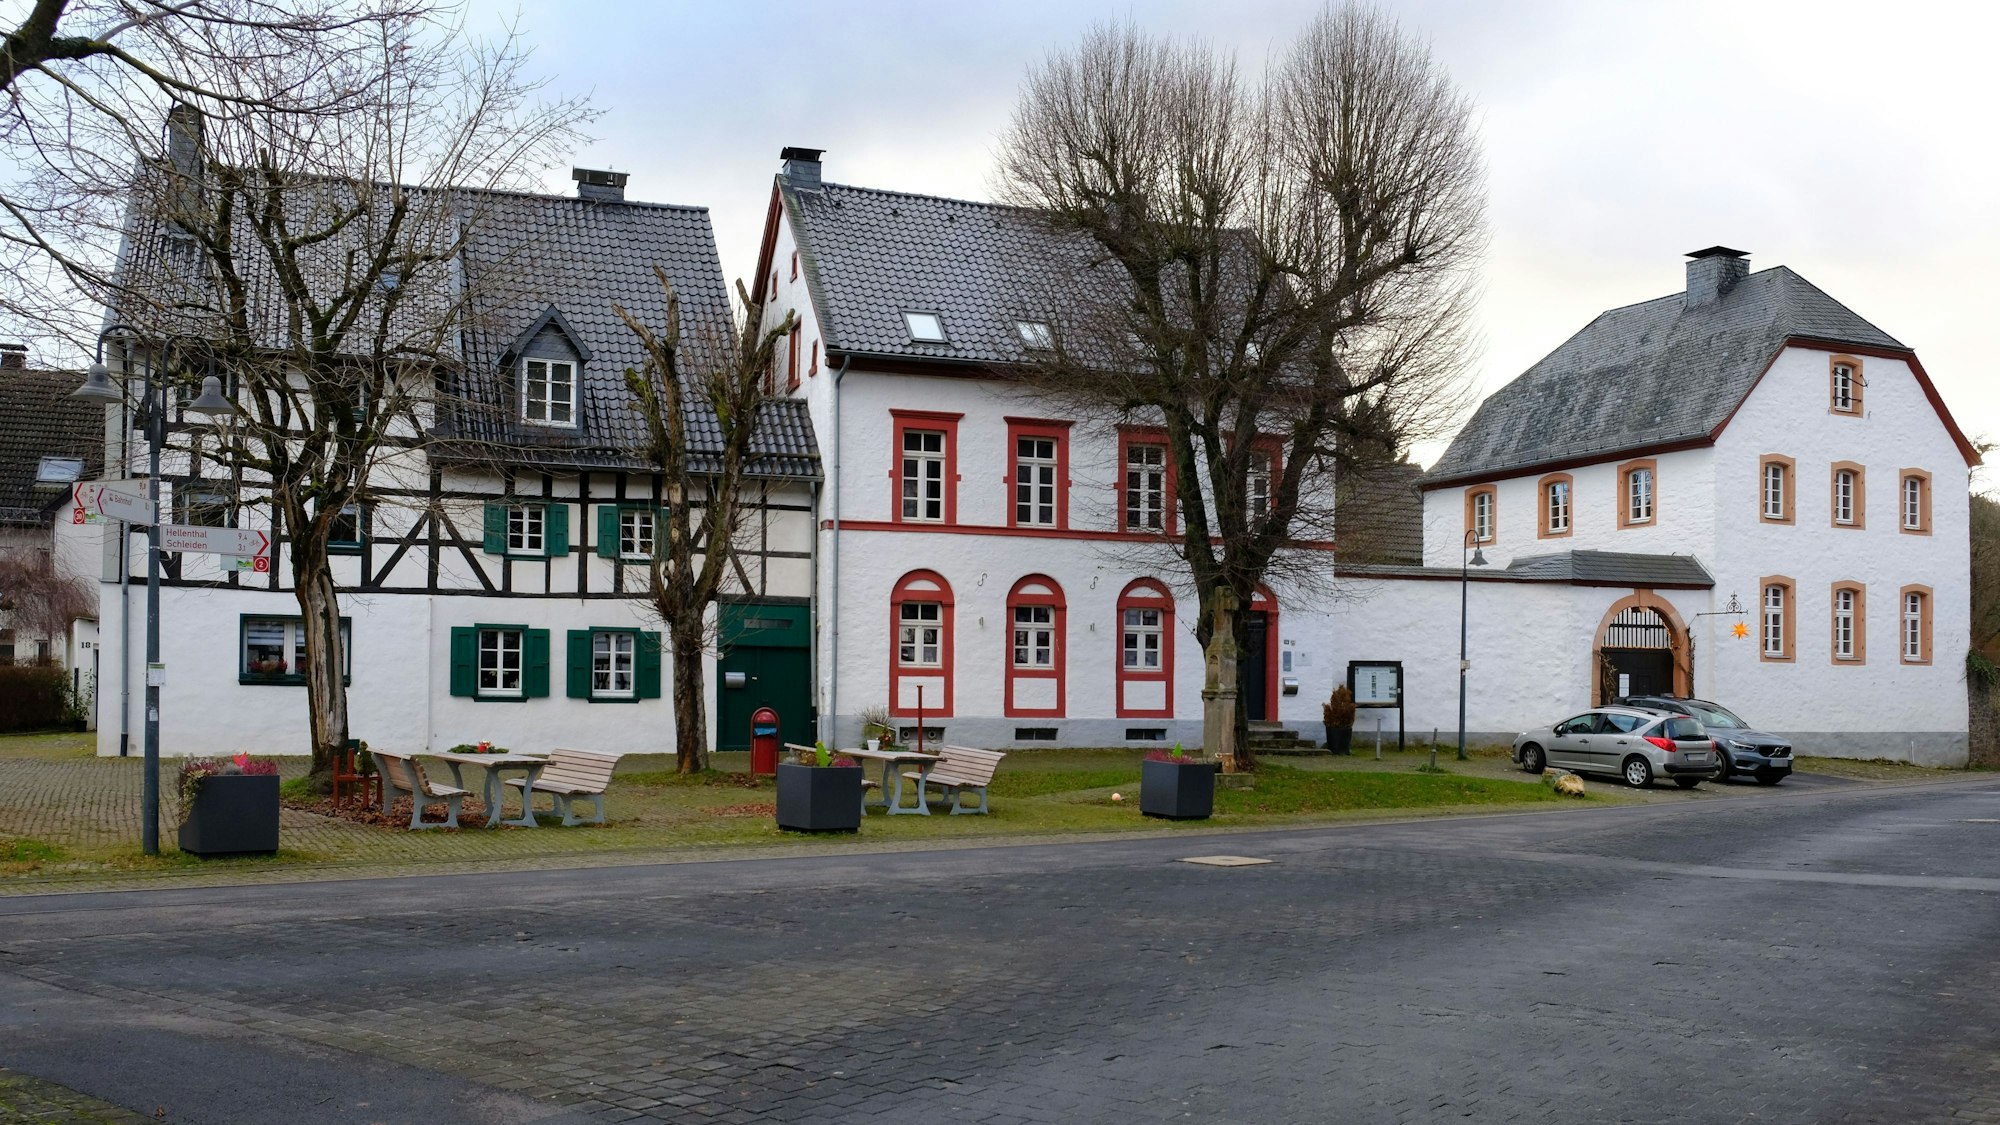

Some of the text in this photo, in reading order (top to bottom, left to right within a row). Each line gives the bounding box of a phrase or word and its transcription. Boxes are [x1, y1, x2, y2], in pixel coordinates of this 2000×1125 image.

[115, 494, 132, 505] Bahnhof
[166, 528, 248, 541] Hellenthal 9,4
[166, 540, 208, 550] Schleiden
[81, 641, 91, 649] 18
